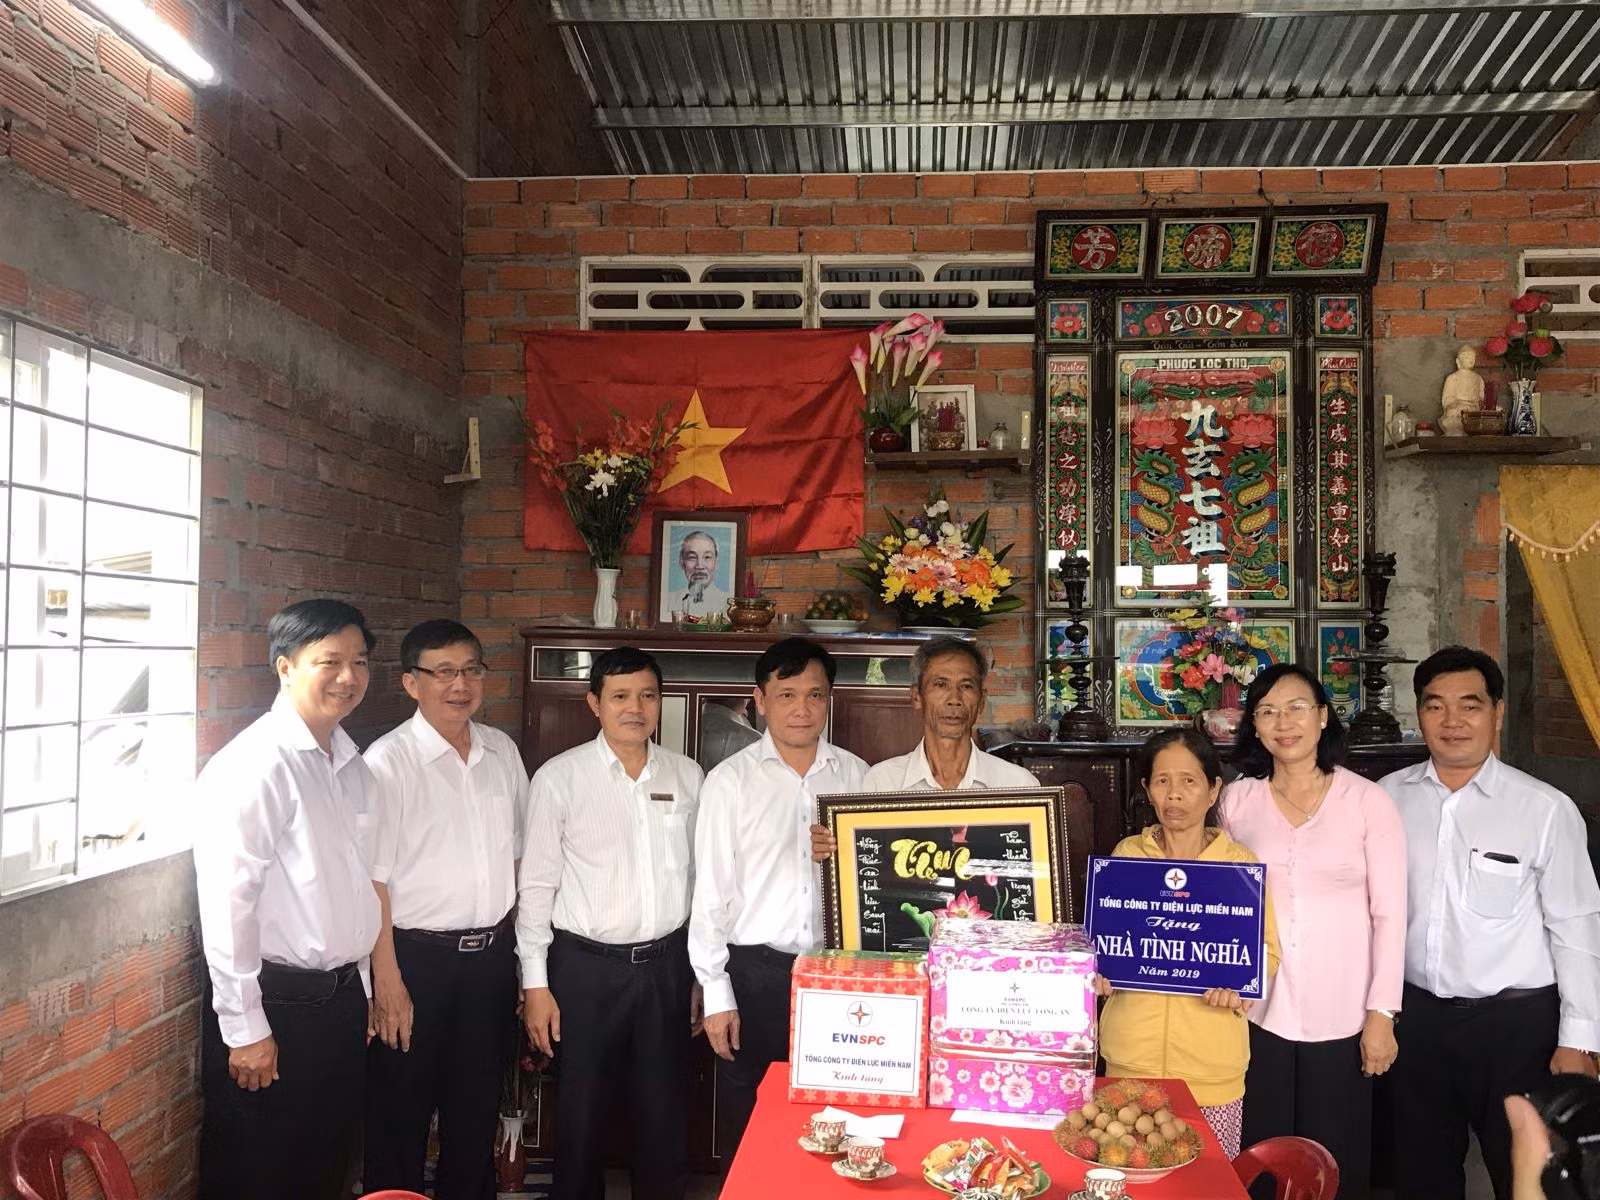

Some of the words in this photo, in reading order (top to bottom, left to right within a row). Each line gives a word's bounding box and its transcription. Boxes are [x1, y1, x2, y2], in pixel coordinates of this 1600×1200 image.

[1074, 227, 1116, 270] 芳
[1164, 304, 1243, 332] 2007
[1180, 400, 1227, 556] 九玄七祖
[1099, 895, 1122, 909] TỔNG
[1124, 898, 1148, 910] CÔNG
[1150, 901, 1161, 911] TY
[1162, 901, 1184, 914] ĐIỆN
[1186, 903, 1203, 915] LỰC
[1231, 906, 1254, 917] NAM
[1146, 916, 1201, 932] Tặng
[1096, 930, 1135, 958] NHÀ
[1140, 932, 1186, 961] TÌNH
[1190, 938, 1252, 966] NGHĨA
[1138, 965, 1168, 977] Năm
[1171, 968, 1201, 979] 2019
[832, 1032, 886, 1046] EVNSPC
[823, 1055, 841, 1064] CÔNG
[842, 1057, 850, 1065] TY
[897, 1061, 912, 1069] NAM
